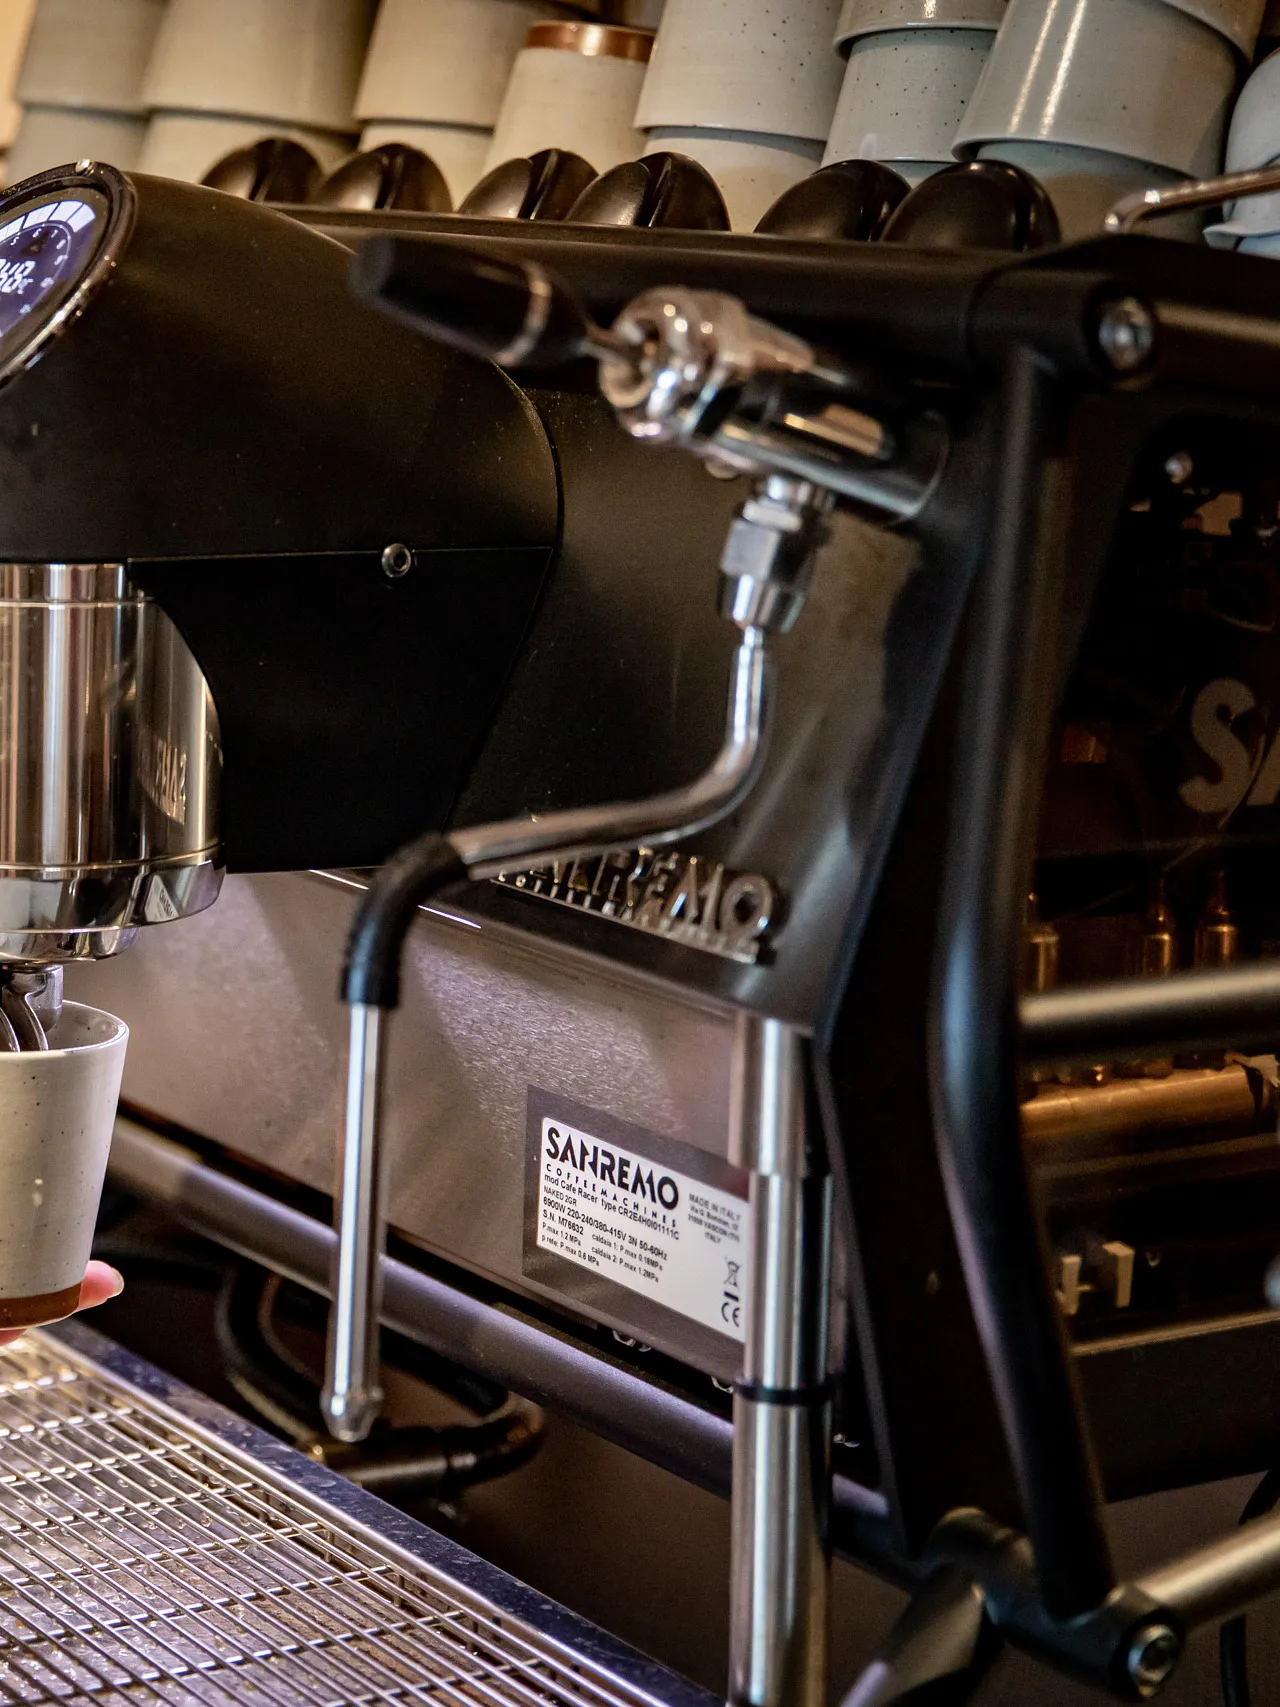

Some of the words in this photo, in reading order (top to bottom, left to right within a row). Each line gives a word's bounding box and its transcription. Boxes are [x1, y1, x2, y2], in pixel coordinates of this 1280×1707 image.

[1179, 677, 1280, 813] S
[545, 1126, 679, 1211] SANREMO
[543, 1185, 564, 1200] NAKED
[564, 1195, 577, 1207] 2GR
[544, 1174, 559, 1186] mod
[560, 1180, 576, 1194] Cafe
[577, 1187, 598, 1204] Racer
[601, 1198, 617, 1213] type
[543, 1196, 566, 1213] 6900W
[567, 1207, 627, 1241] 220-240/380-415V
[639, 1240, 668, 1261] 50-60Hz
[569, 1234, 581, 1247] MPa
[591, 1233, 612, 1248] caldaia
[587, 1253, 600, 1267] MPa
[591, 1246, 611, 1261] caldaia
[721, 1302, 740, 1328] CE
